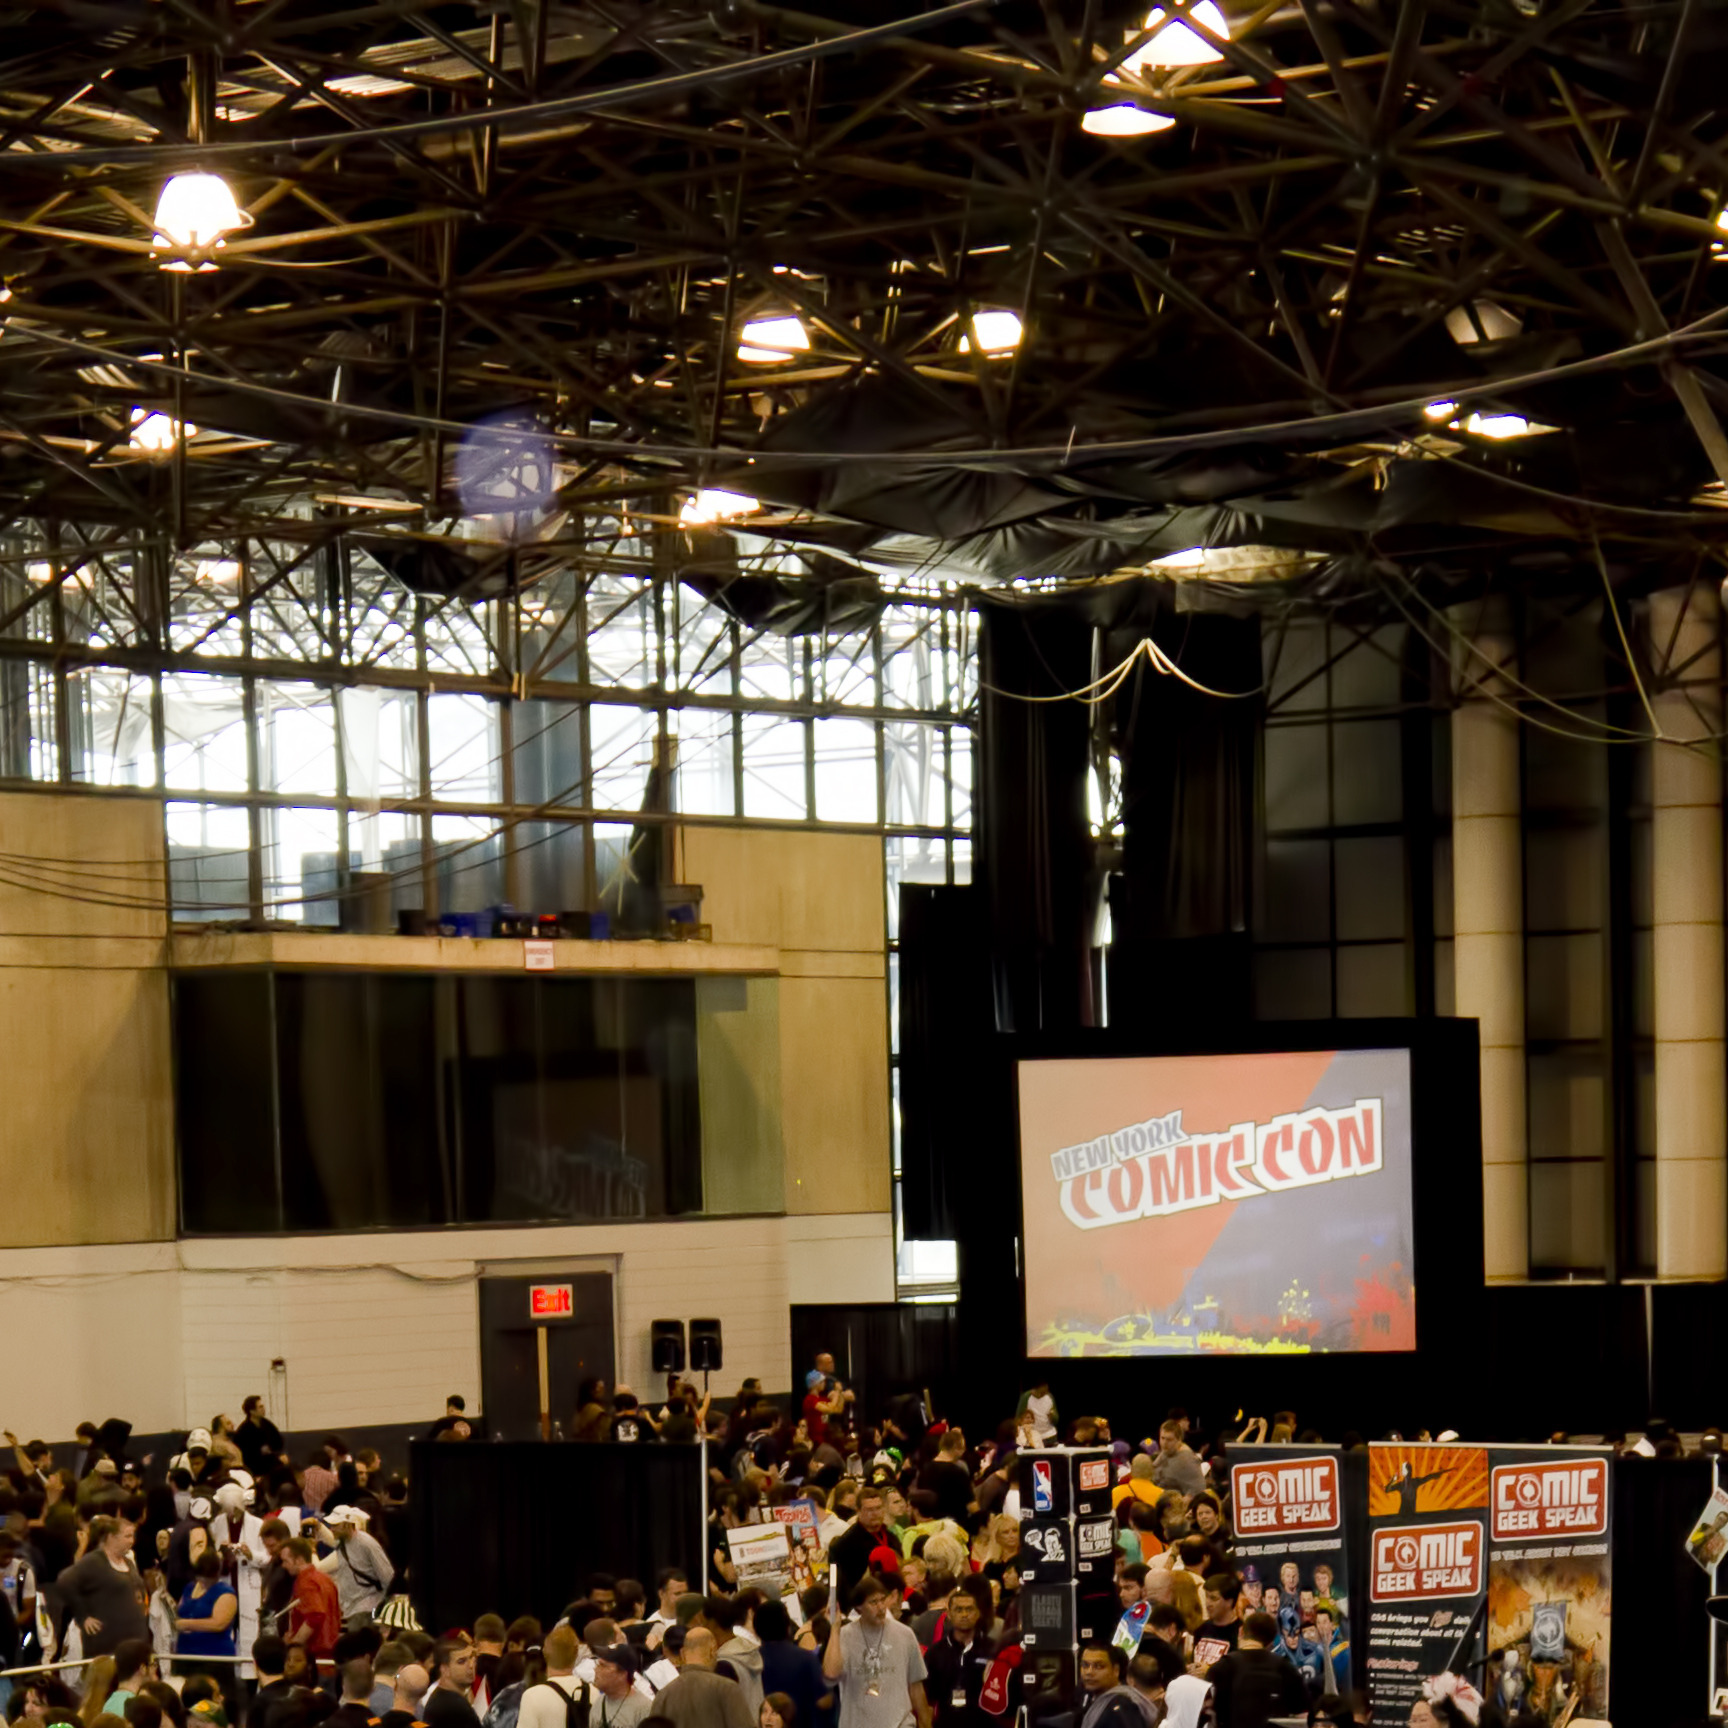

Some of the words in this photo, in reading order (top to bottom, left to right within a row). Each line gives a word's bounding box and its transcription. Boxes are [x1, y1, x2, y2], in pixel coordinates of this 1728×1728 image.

[1053, 1137, 1113, 1180] NEW
[1112, 1115, 1186, 1160] YORK
[1068, 1128, 1248, 1222] COMIC
[1258, 1103, 1378, 1185] CON
[1239, 1466, 1331, 1507] COMIC
[1498, 1468, 1600, 1511] COMIC
[1240, 1506, 1278, 1528] GEEK
[1282, 1501, 1332, 1525] SPEAK
[1497, 1509, 1540, 1532] GEEK
[1545, 1505, 1598, 1528] SPEAK
[1377, 1531, 1474, 1573] COMIC
[1376, 1571, 1417, 1593] GEEK
[1421, 1567, 1472, 1590] SPEAK
